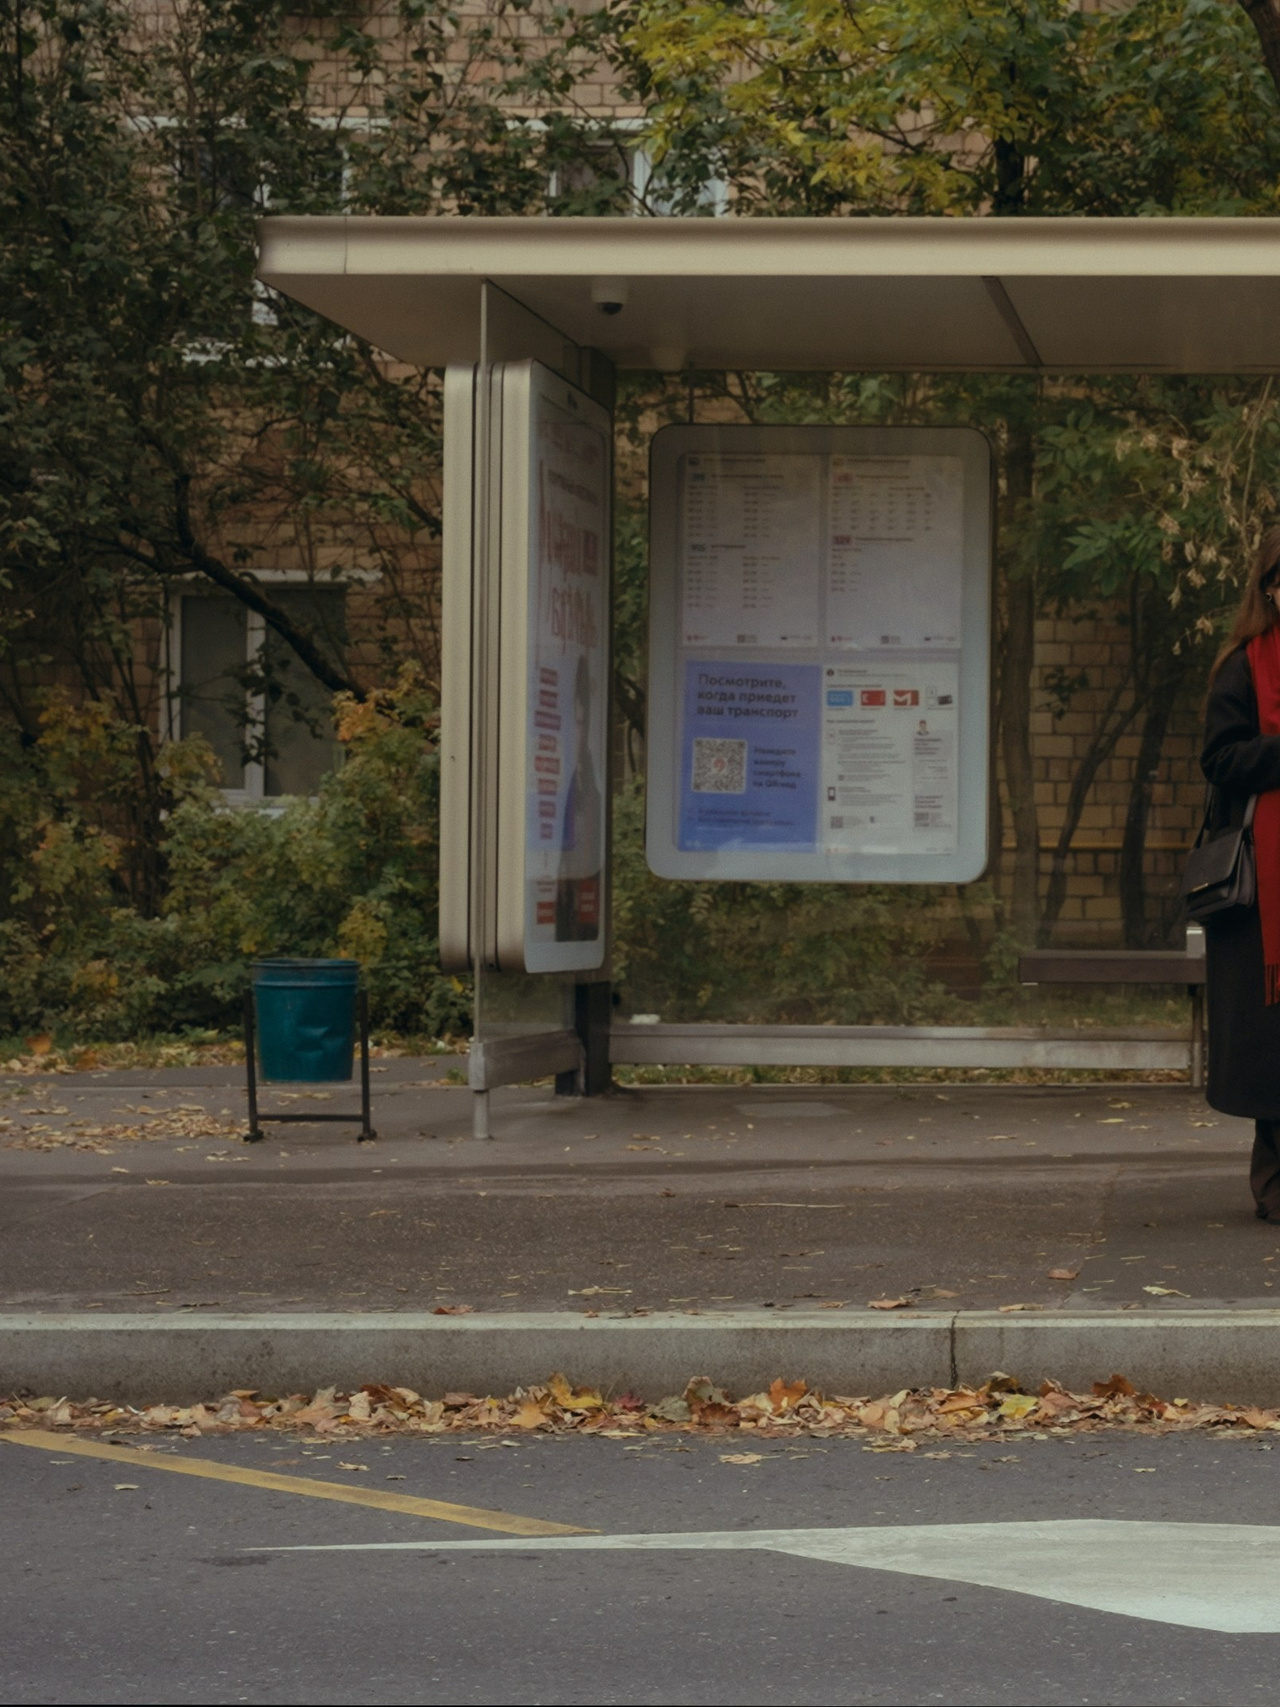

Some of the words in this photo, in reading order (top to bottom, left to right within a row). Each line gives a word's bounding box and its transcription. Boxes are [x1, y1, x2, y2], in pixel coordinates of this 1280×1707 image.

[698, 691, 736, 702] когда
[739, 692, 796, 704] приедет
[697, 706, 725, 716] ваш
[727, 706, 798, 719] транспорт
